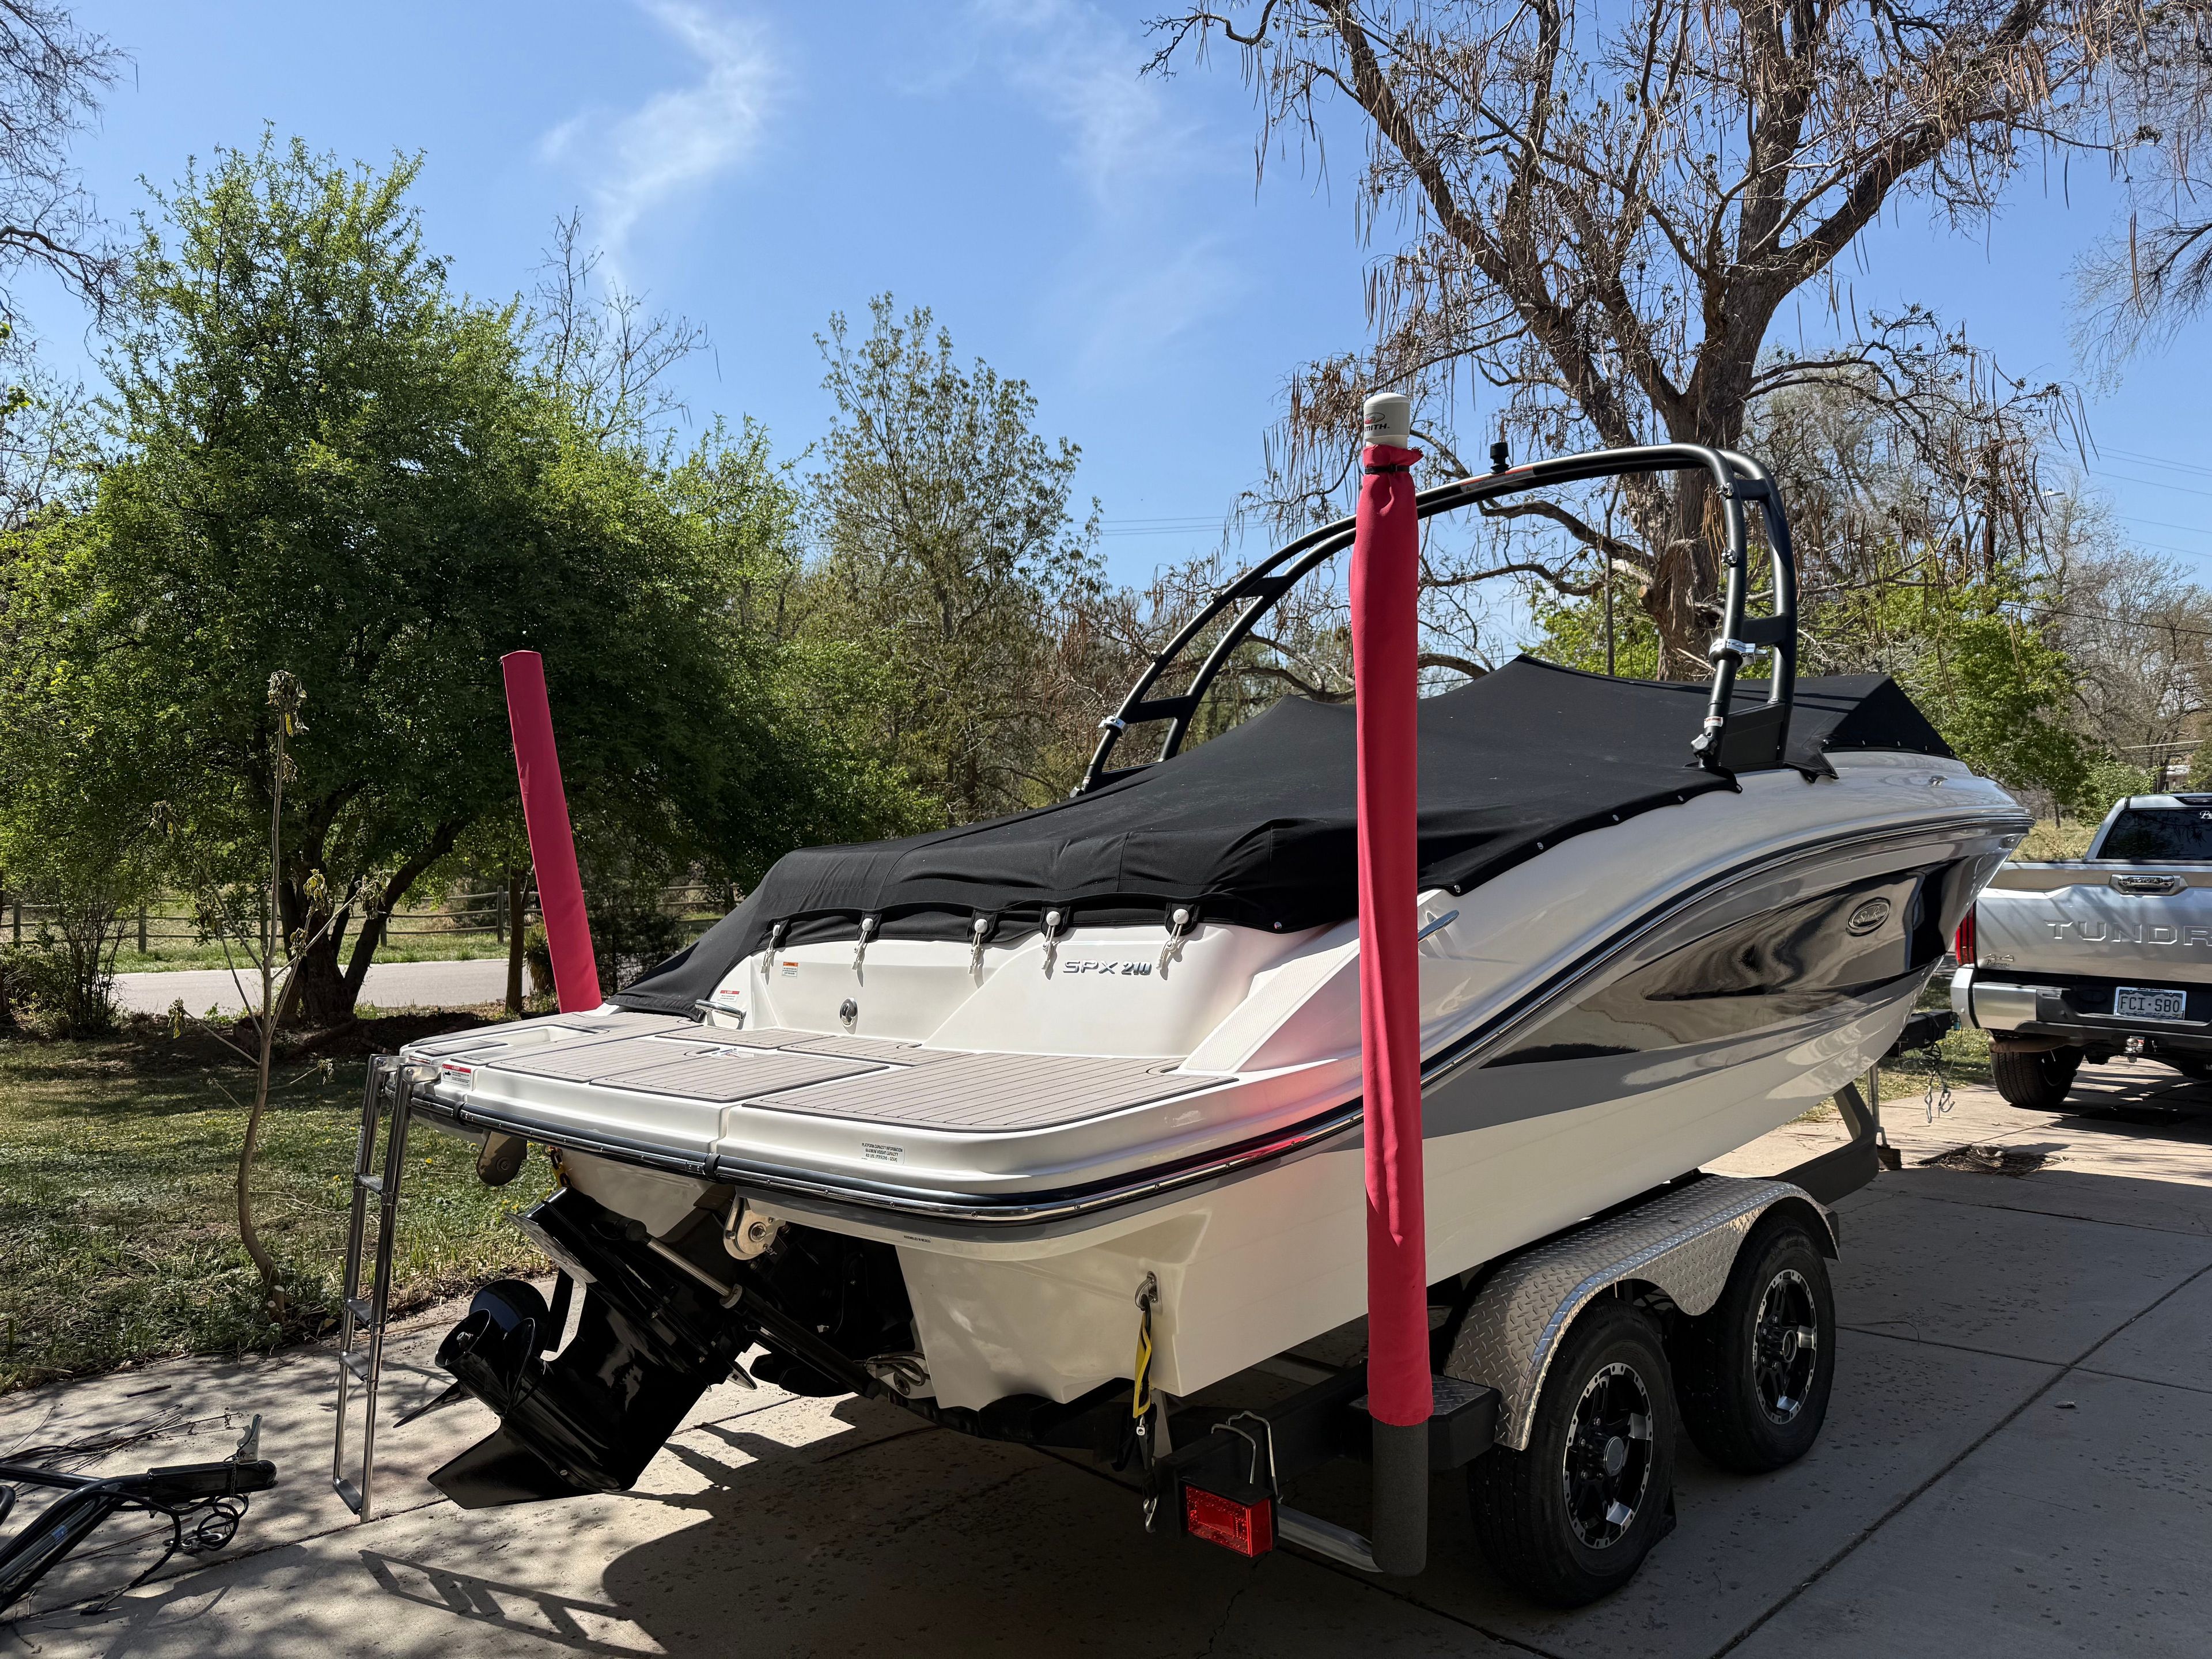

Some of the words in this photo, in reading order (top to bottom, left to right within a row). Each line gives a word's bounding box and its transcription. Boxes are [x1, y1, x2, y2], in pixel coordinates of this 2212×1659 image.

[1363, 423, 1387, 431] MITH
[1063, 960, 1118, 974] SPX
[1121, 961, 1153, 975] 210
